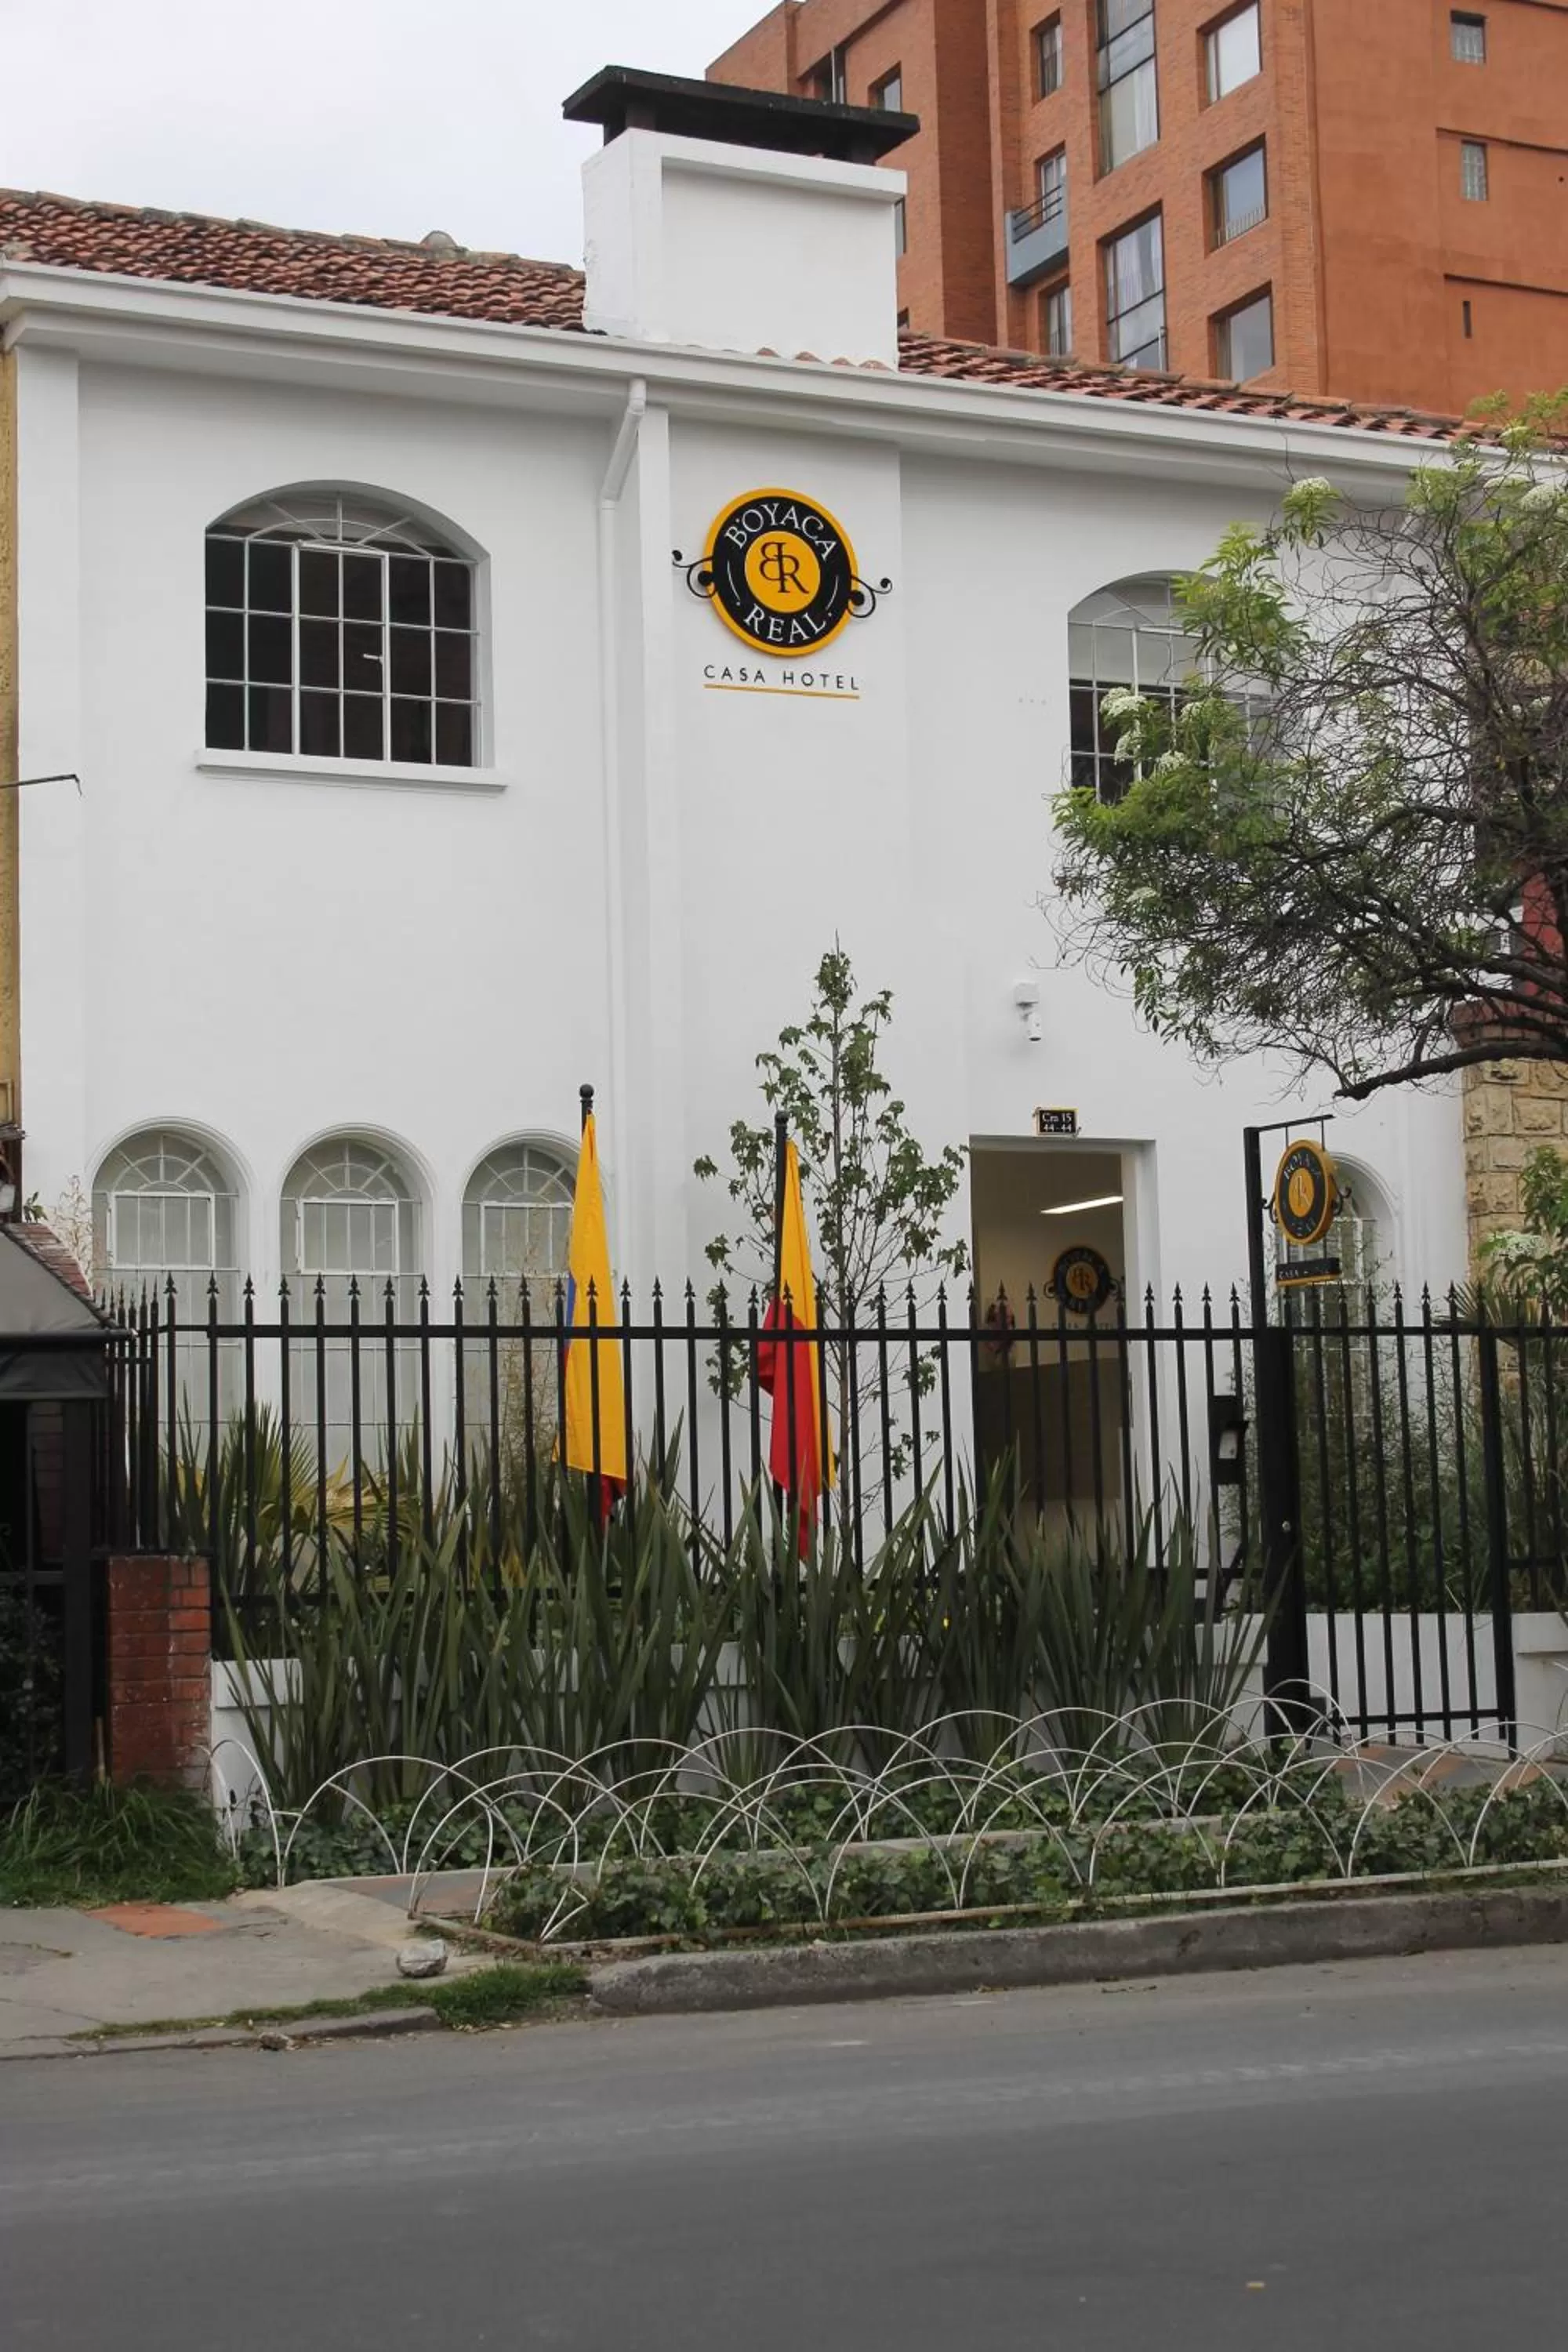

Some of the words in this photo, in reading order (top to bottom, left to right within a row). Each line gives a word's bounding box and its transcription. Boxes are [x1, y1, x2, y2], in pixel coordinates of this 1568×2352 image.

[724, 503, 837, 560] BOYACA
[744, 604, 826, 644] REAL
[703, 665, 765, 683] CASA
[783, 671, 859, 691] HOTEL
[1062, 1112, 1073, 1122] 15
